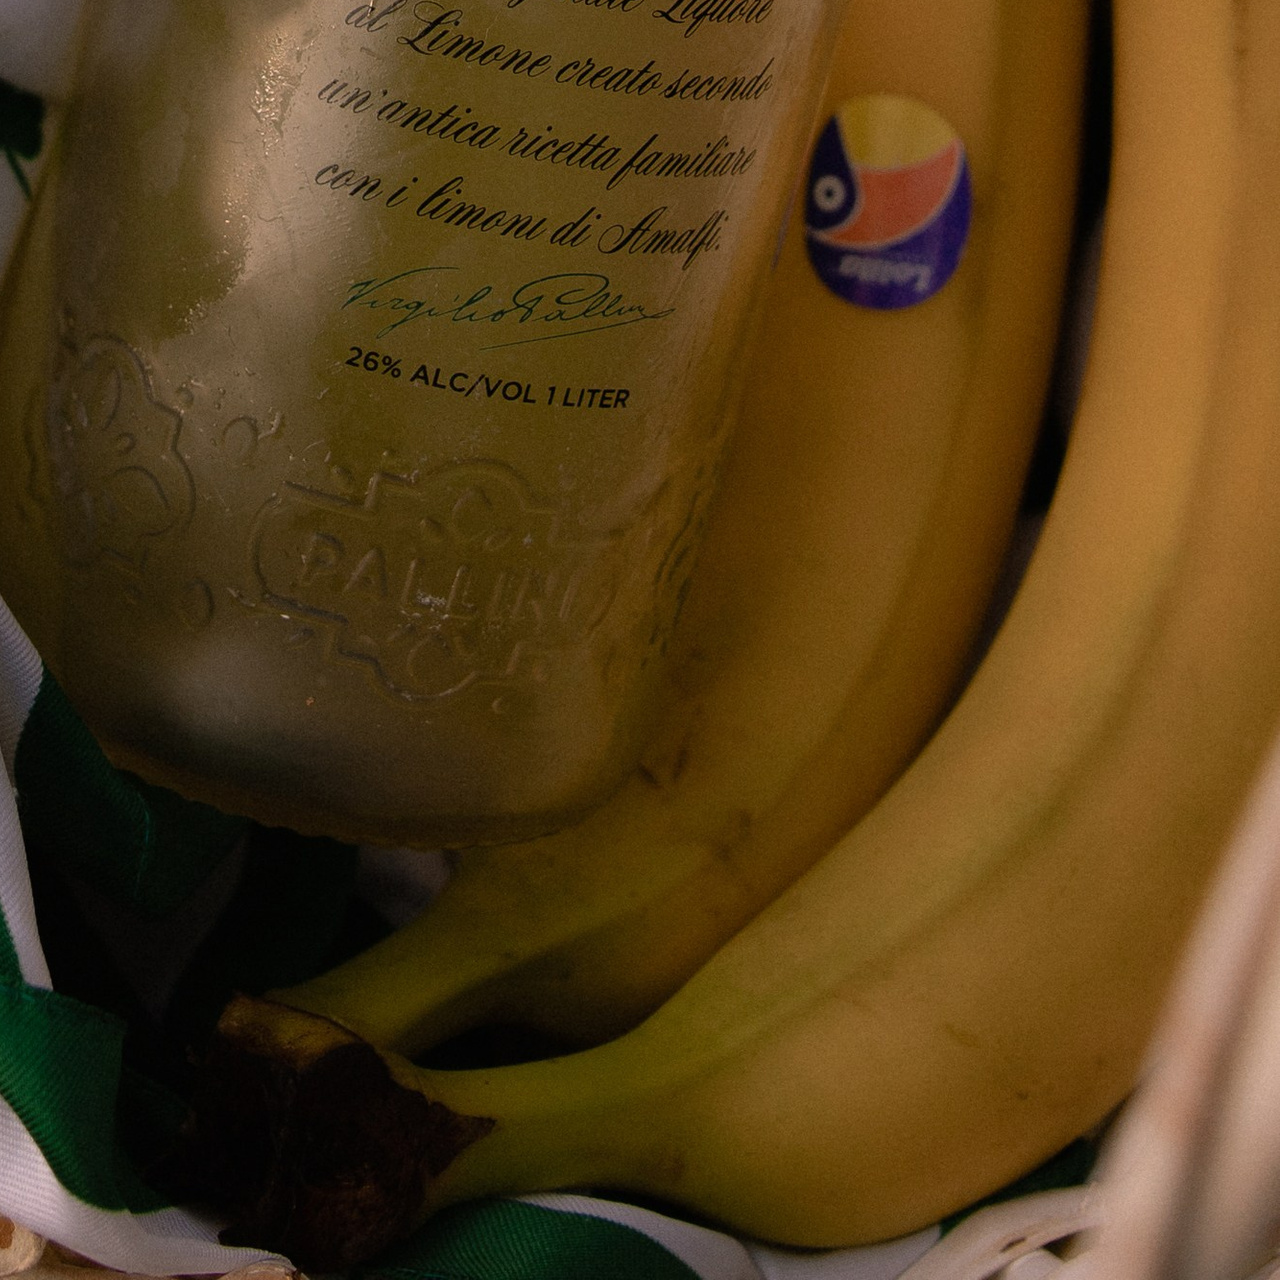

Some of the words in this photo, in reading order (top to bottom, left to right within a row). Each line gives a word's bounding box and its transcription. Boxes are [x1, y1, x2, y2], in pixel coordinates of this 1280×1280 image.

[396, 0, 553, 78] Limone
[554, 58, 663, 96] creato
[662, 56, 775, 102] secondo
[316, 77, 503, 150] un'antica
[500, 124, 624, 172] ricetta
[605, 132, 758, 191] familiare
[314, 159, 386, 202] con
[385, 176, 419, 208] i
[415, 175, 553, 241] limoni
[549, 206, 603, 248] di
[597, 205, 730, 271] Amalfi.
[344, 346, 403, 379] 26%
[408, 363, 538, 405] ALC/VOL
[545, 385, 557, 406] 1
[561, 387, 631, 410] LITER
